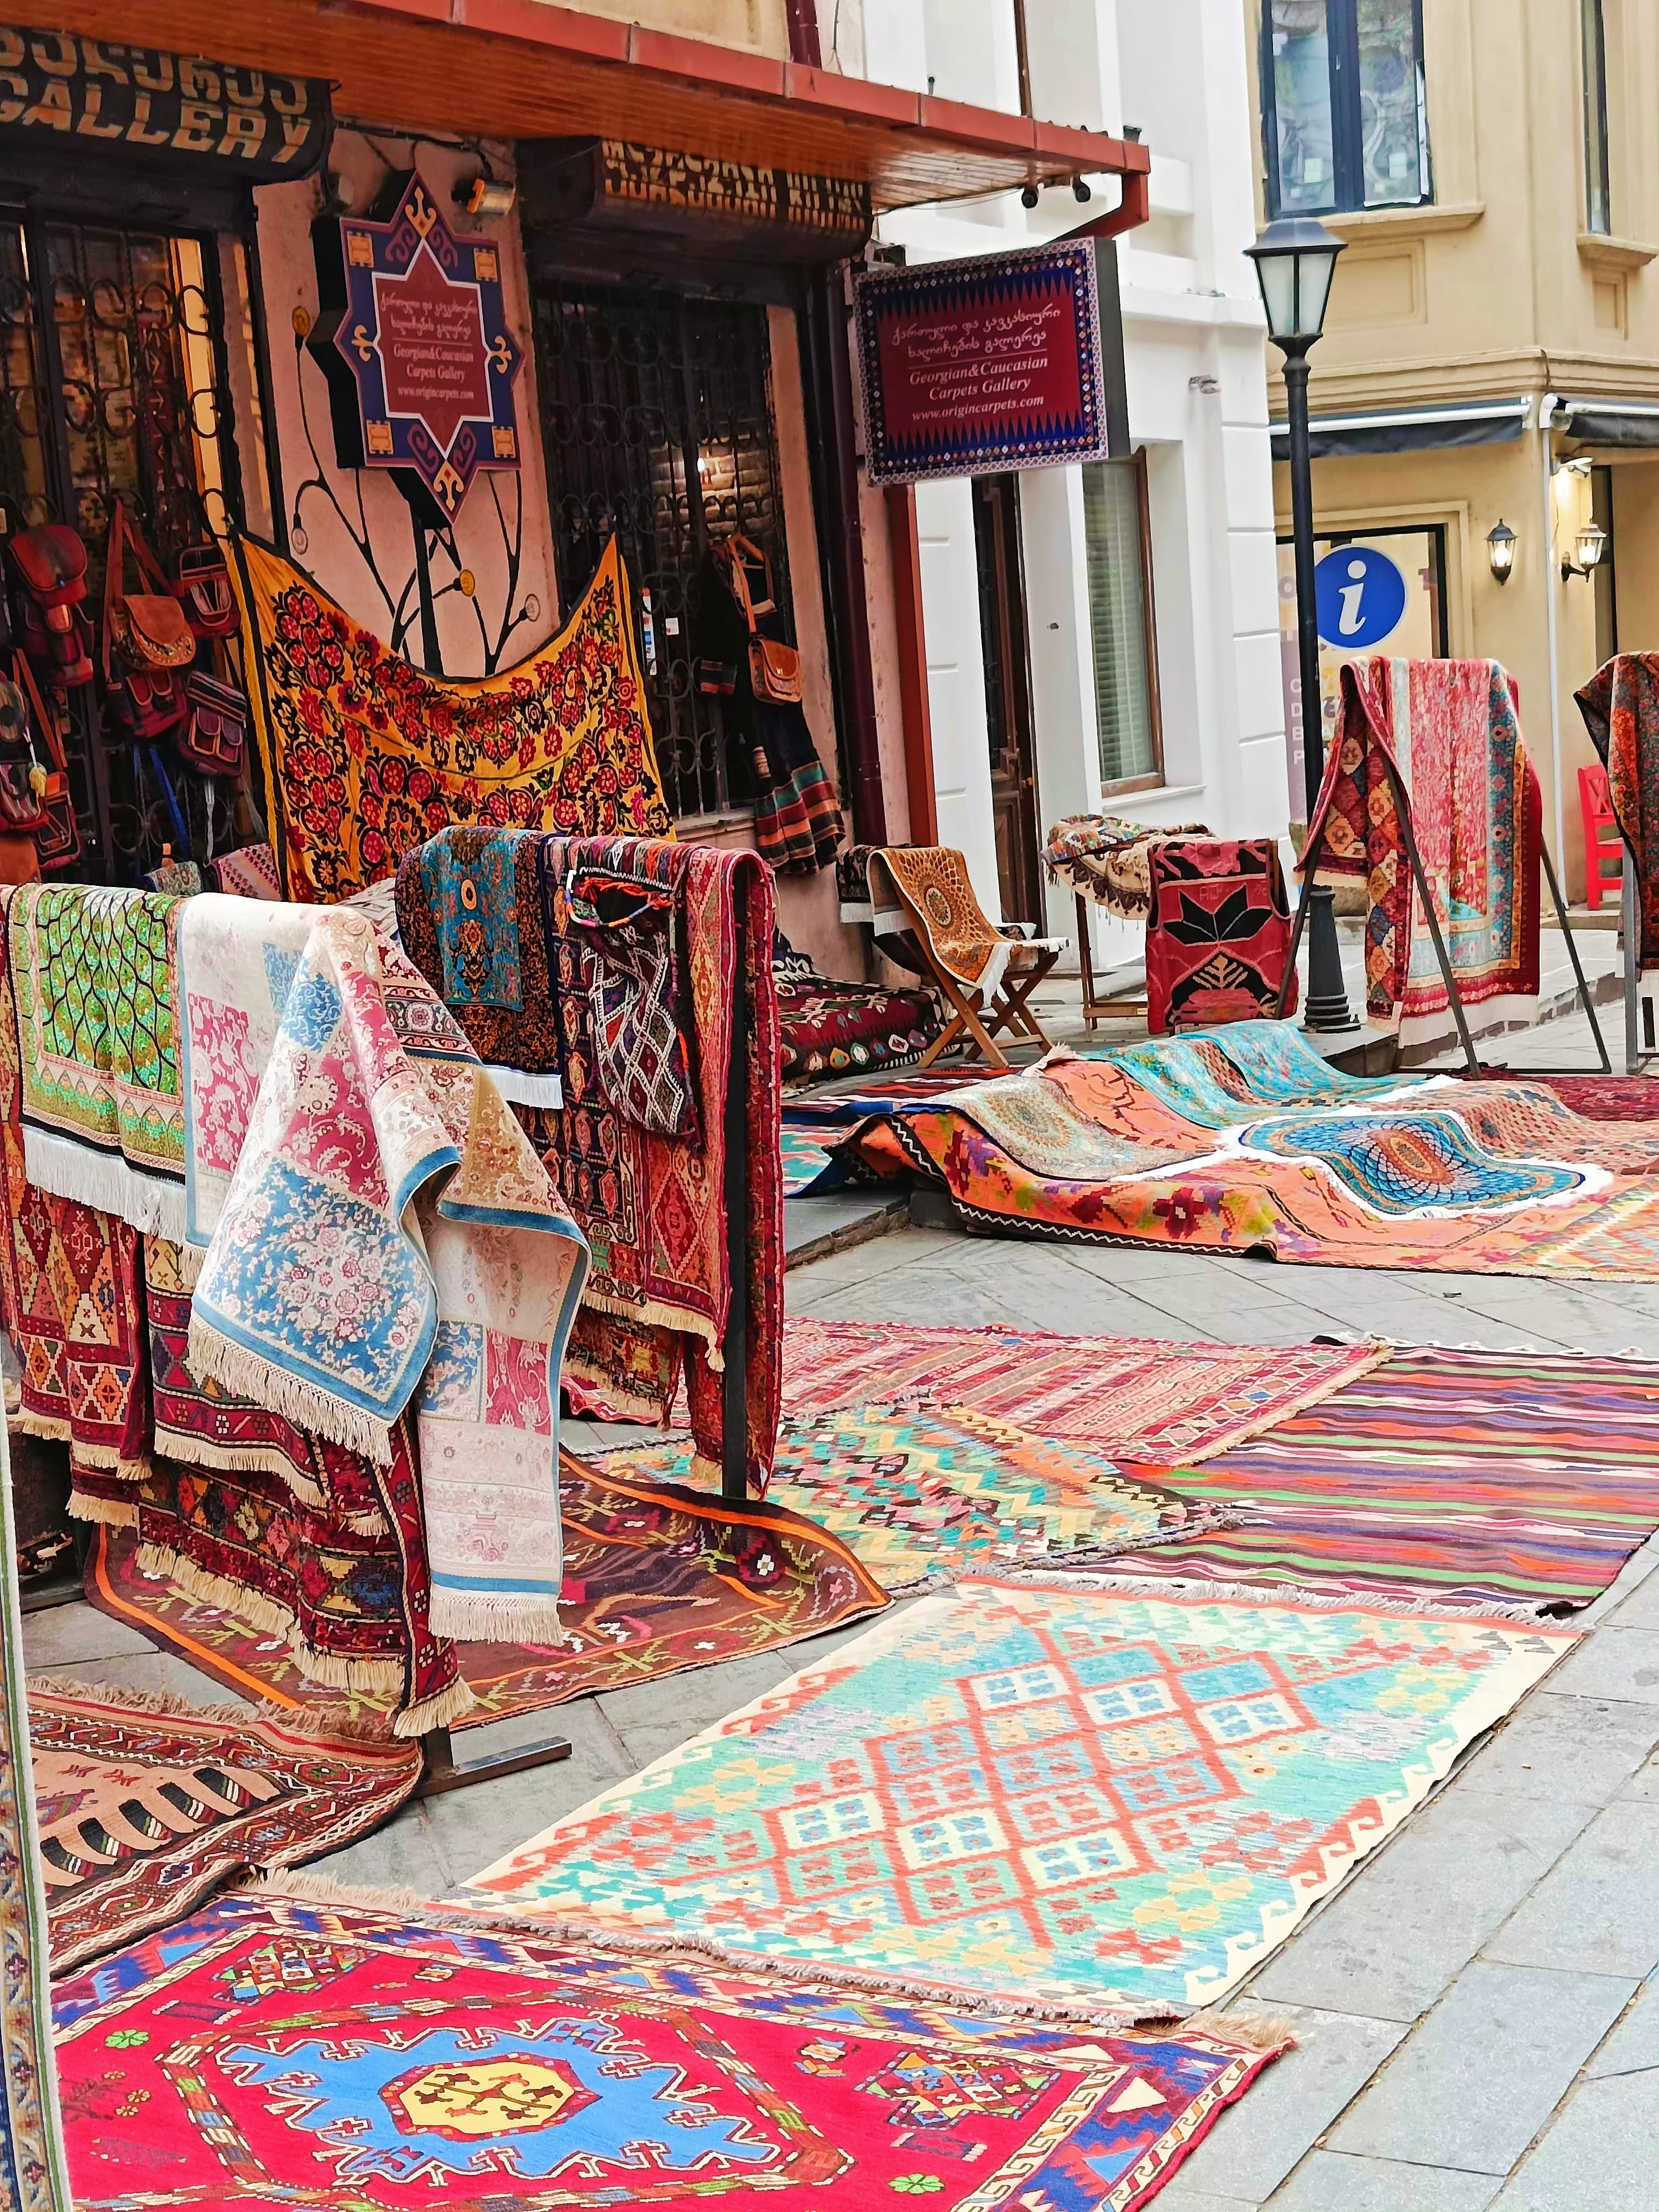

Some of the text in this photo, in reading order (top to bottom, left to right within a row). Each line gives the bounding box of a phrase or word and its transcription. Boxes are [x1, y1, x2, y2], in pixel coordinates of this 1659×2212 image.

[892, 302, 1061, 346] ქართული და კავკასიური
[908, 327, 1046, 362] ხალიჩების გალერეა
[407, 364, 466, 383] Carpets Gallery
[910, 357, 1048, 385] Georgian&Caucasian
[398, 387, 474, 401] www.origincarpets.com
[929, 377, 1031, 401] Carpets Gallery
[912, 395, 1044, 420] www.origincarpets.com
